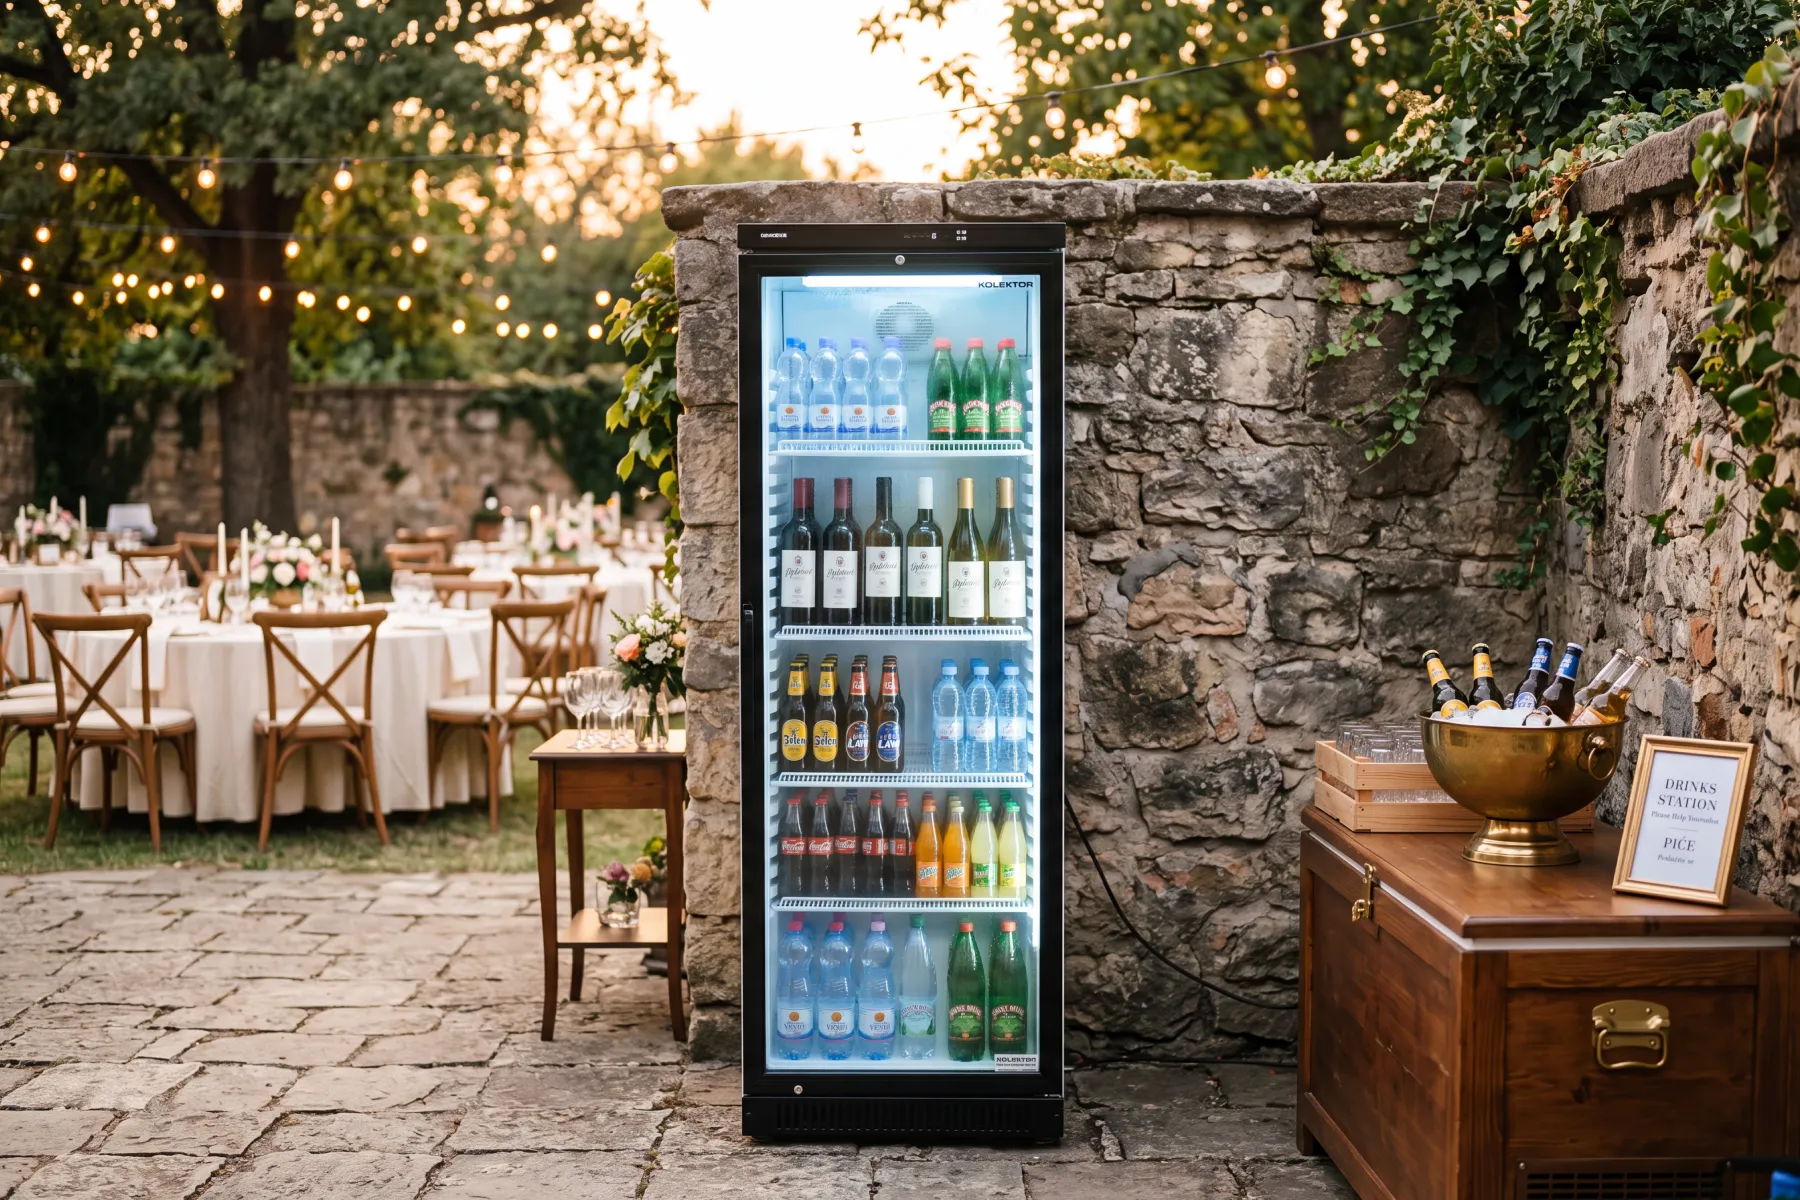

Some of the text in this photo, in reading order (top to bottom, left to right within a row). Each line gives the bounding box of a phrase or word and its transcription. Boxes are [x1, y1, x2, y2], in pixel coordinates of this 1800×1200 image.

[1665, 778, 1717, 794] DRINKS
[1657, 794, 1718, 811] STATION
[1663, 836, 1696, 851] PIĆE
